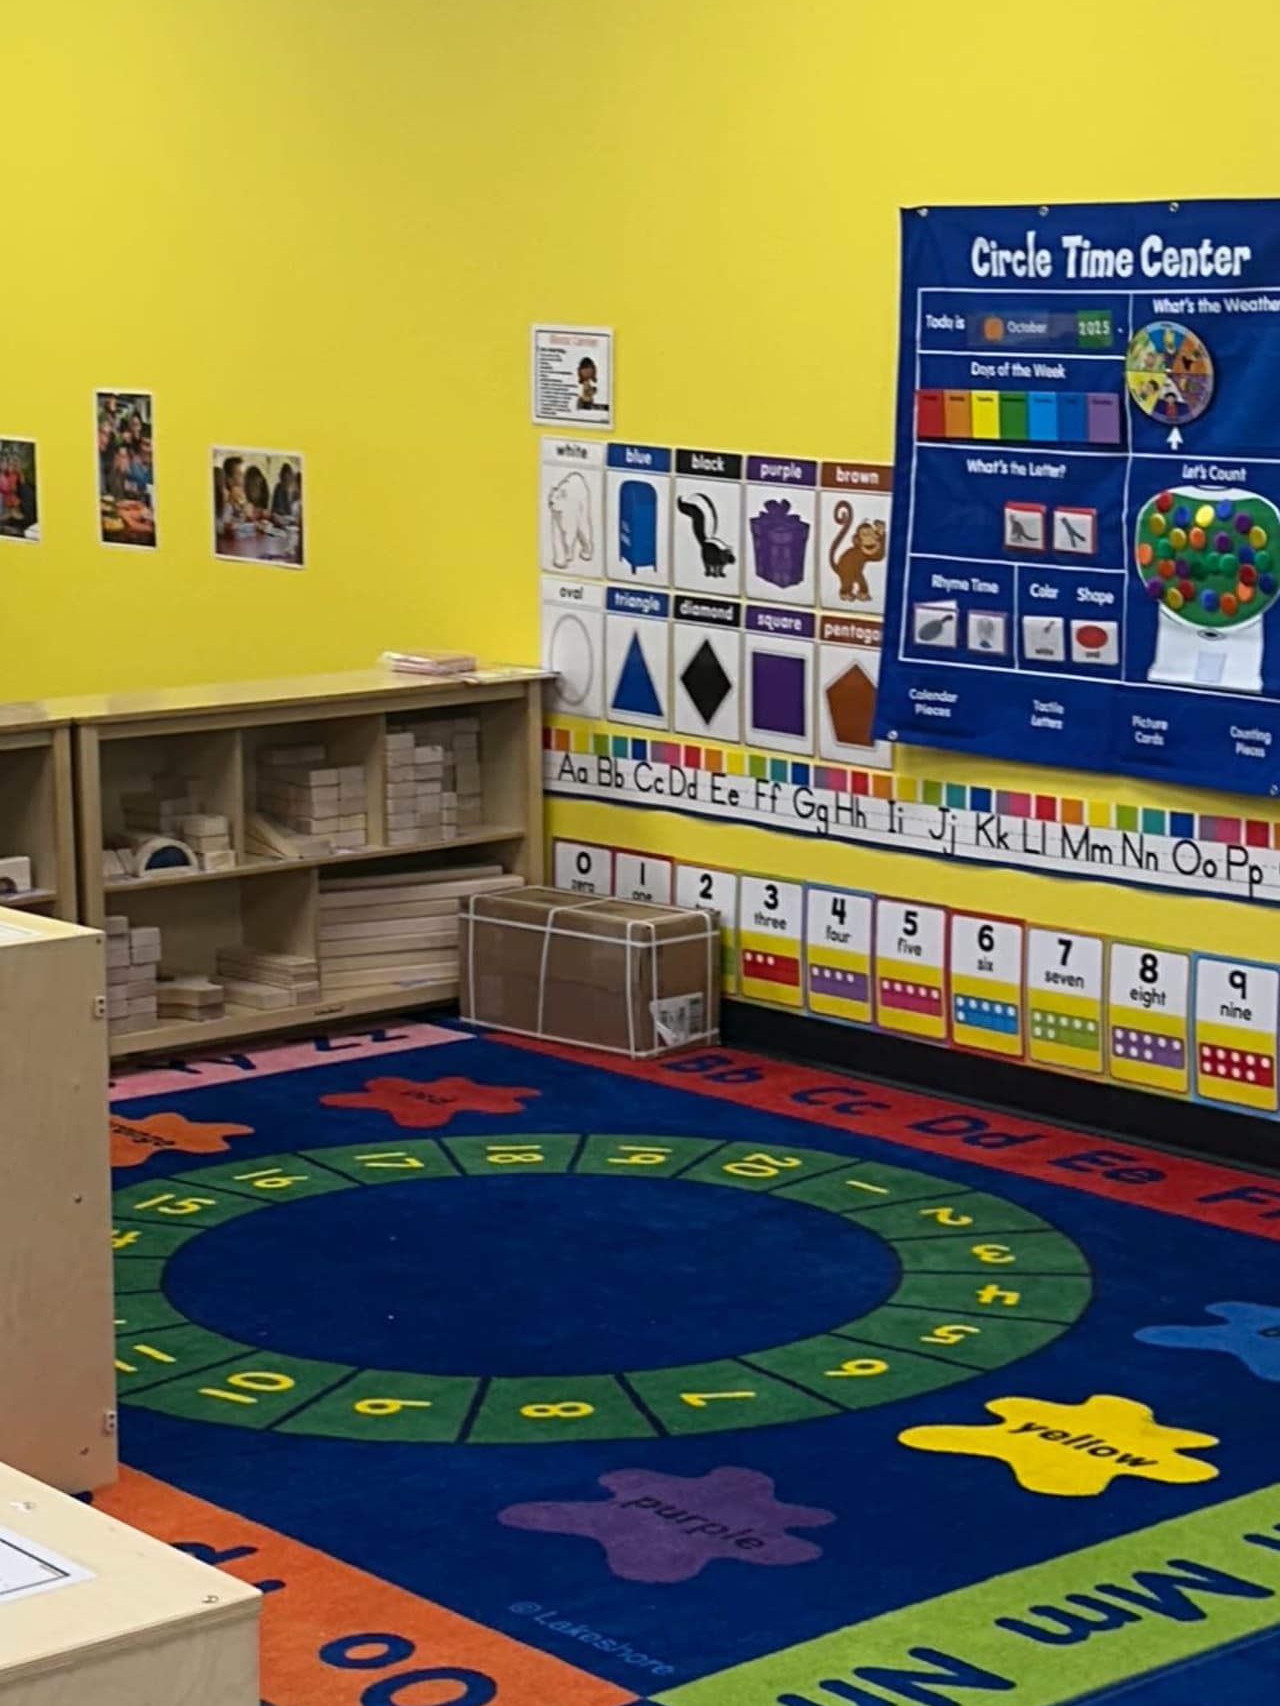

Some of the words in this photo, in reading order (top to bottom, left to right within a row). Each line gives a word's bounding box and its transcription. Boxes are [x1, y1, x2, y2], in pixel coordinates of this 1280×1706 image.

[971, 230, 1053, 278] Circle
[1061, 234, 1134, 278] Time
[1140, 234, 1252, 278] Center
[1153, 297, 1195, 314] What's
[1198, 298, 1221, 313] the
[955, 315, 966, 329] is
[1007, 321, 1048, 334] October
[1078, 320, 1111, 336] 2025
[971, 362, 996, 379] Days
[997, 362, 1009, 377] of
[1012, 363, 1032, 377] the
[1033, 363, 1067, 378] Week
[556, 444, 588, 460] white
[625, 449, 653, 466] blue
[691, 455, 726, 474] black
[760, 463, 803, 481] purple
[966, 459, 1008, 475] What's
[1010, 461, 1027, 476] the
[1029, 462, 1067, 478] Letter?
[1181, 463, 1207, 480] Let's
[1208, 465, 1247, 481] Count
[835, 469, 879, 486] brown
[559, 586, 584, 600] oval
[931, 574, 970, 593] Rhyme
[971, 578, 999, 594] Time
[1029, 583, 1059, 599] Color
[1076, 588, 1114, 606] Shape
[614, 591, 660, 613] triangle
[680, 600, 734, 621] diamond
[757, 613, 802, 631] square
[824, 622, 881, 644] pentago
[908, 688, 959, 703] Calendar
[1131, 715, 1168, 731] Picture
[1134, 730, 1165, 745] Cards
[1229, 726, 1272, 745] Counting
[558, 753, 588, 784] Aa
[597, 755, 625, 788] Bb
[633, 762, 664, 794] Cc
[670, 766, 698, 800] Dd
[710, 772, 739, 807] Ee
[754, 779, 782, 814] Ff
[793, 786, 829, 835] Gg
[835, 792, 867, 829] Hh
[887, 800, 904, 834] Ii
[928, 806, 958, 854] Jj
[976, 813, 1009, 850] Kk
[1023, 818, 1046, 857] Ll
[1061, 824, 1113, 865] Mm
[1121, 832, 1159, 872] Nn
[1172, 839, 1217, 881] Oo
[1226, 845, 1264, 900] Pp
[576, 851, 592, 874] 0
[640, 862, 646, 886] 1
[571, 879, 595, 893] zero
[631, 891, 652, 901] one
[699, 873, 713, 899] 2
[763, 884, 779, 910] 3
[754, 912, 788, 931] three
[831, 897, 847, 926] 4
[902, 910, 918, 937] 5
[825, 927, 852, 945] four
[977, 925, 995, 952] 6
[897, 938, 922, 957] five
[1056, 939, 1073, 966] 7
[975, 955, 994, 973] six
[1139, 953, 1159, 983] 8
[1044, 972, 1085, 990] seven
[1228, 969, 1248, 1000] 9
[1129, 983, 1167, 1008] eight
[1220, 1002, 1253, 1022] nine
[659, 1054, 765, 1084] Bb
[789, 1086, 892, 1116] Cc
[904, 1114, 1049, 1149] Dd
[1046, 1149, 1167, 1184] Ee
[354, 1150, 426, 1172] 17
[485, 1143, 543, 1166] 18
[607, 1145, 673, 1168] 19
[722, 1150, 802, 1179] 20
[233, 1166, 309, 1190] 16
[133, 1193, 218, 1215] 15
[920, 1207, 974, 1228] 2
[970, 1243, 1016, 1264] 3
[975, 1283, 1020, 1306] 4
[920, 1325, 980, 1346] 5
[198, 1371, 296, 1404] 10
[520, 1400, 595, 1418] 8
[680, 1389, 757, 1408] 7
[1010, 1417, 1160, 1470] yellow
[621, 1496, 765, 1550] purple
[995, 1558, 1276, 1646] Mm
